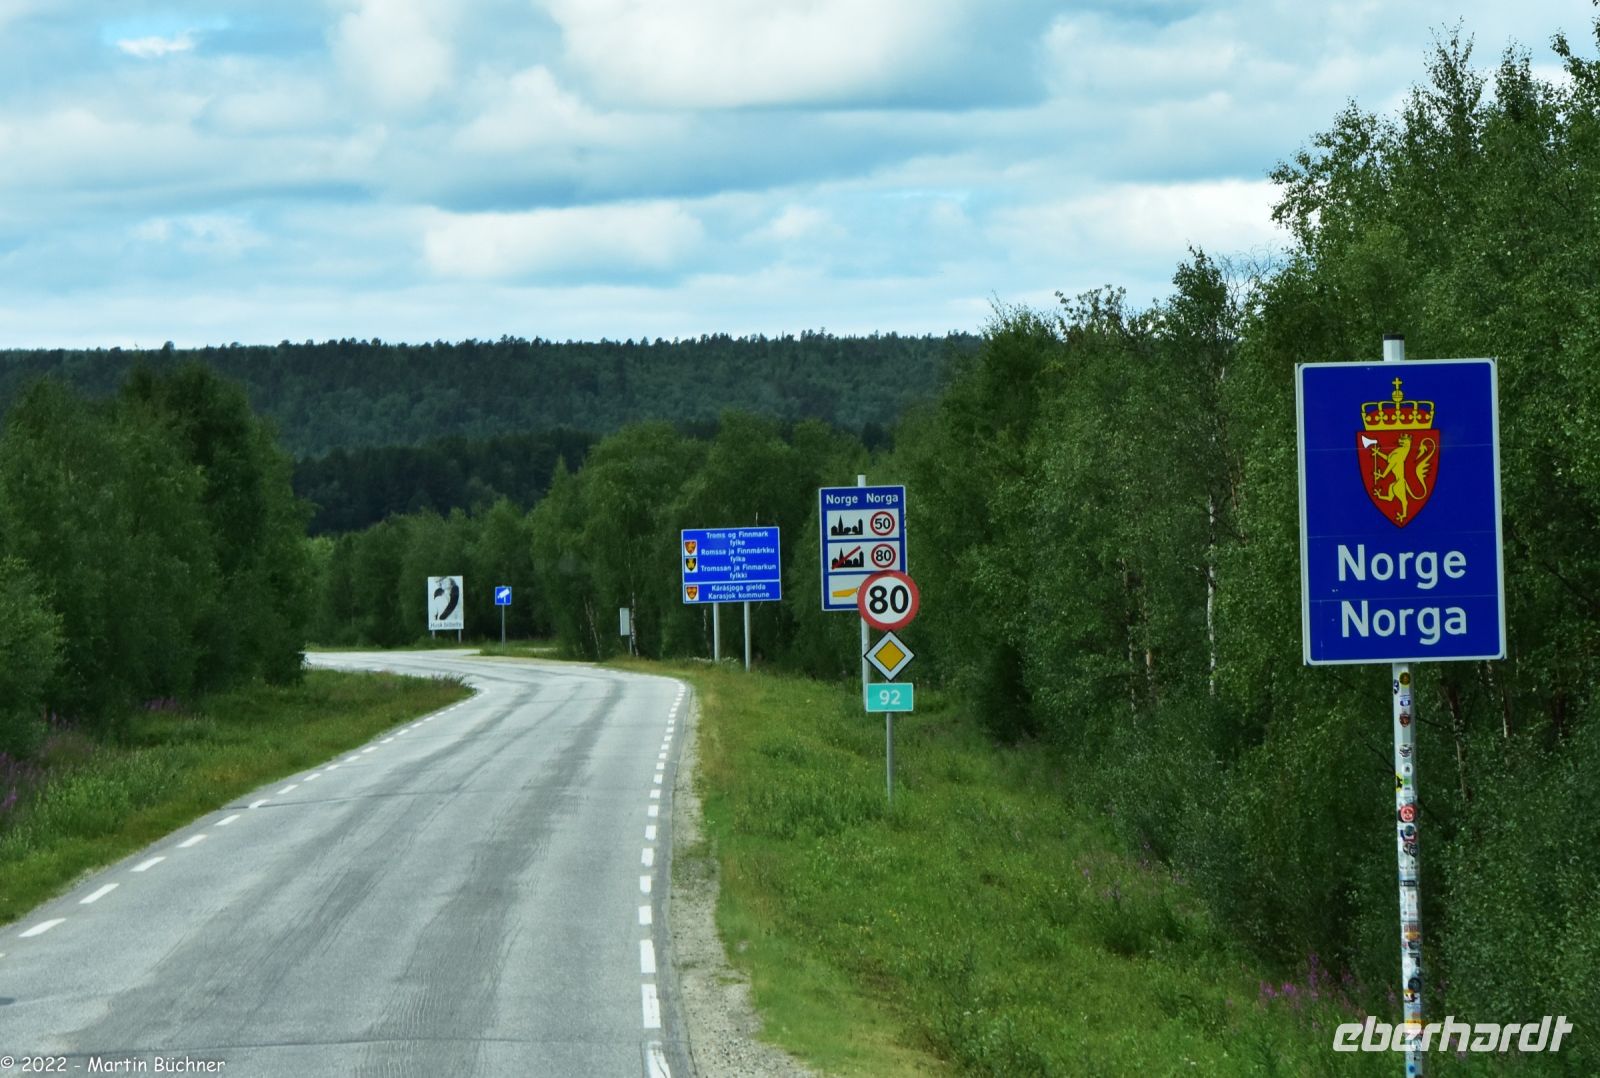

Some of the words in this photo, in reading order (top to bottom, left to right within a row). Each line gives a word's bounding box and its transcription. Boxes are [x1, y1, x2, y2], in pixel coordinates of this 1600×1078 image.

[826, 494, 858, 506] Norge
[866, 493, 898, 505] Norga
[874, 517, 891, 530] 50
[701, 548, 727, 556] Romssa
[728, 548, 735, 556] ja
[875, 549, 892, 562] 80
[1337, 544, 1467, 590] Norge
[729, 572, 748, 580] fylkki
[746, 583, 766, 591] gielda
[869, 585, 909, 614] 80
[1341, 600, 1467, 646] Norga
[879, 690, 901, 705] 92
